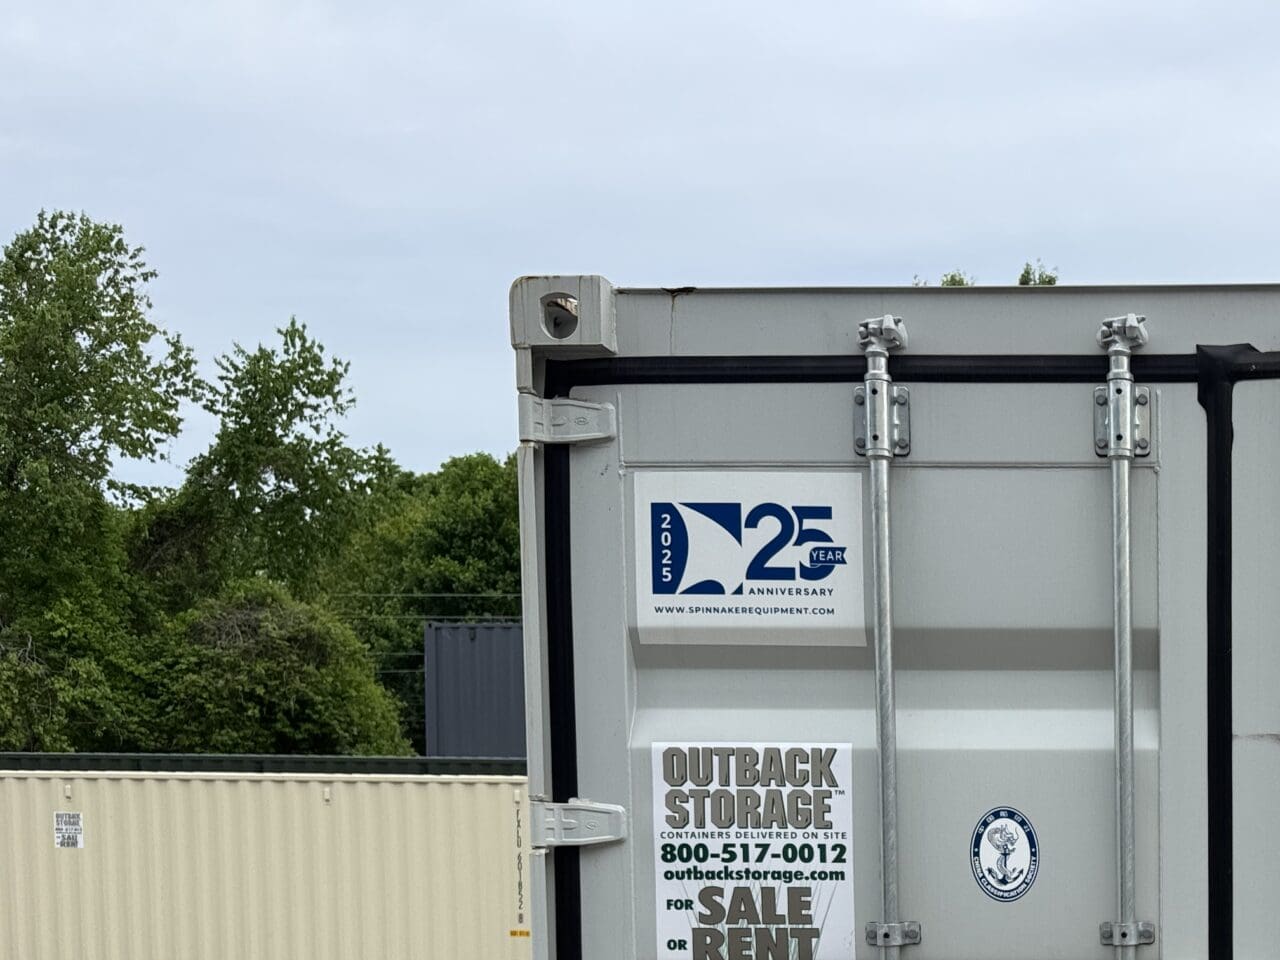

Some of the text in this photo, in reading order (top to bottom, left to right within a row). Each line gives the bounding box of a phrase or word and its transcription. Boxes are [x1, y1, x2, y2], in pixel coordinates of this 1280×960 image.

[660, 513, 673, 582] 2025
[744, 503, 844, 581] 25 YEAR
[748, 587, 834, 597] ANNIVERSARY
[653, 605, 836, 616] WWW.SPINNAKEREQUIPMENT.COM
[662, 747, 839, 788] OUTBACK
[665, 789, 833, 830] STORAGE
[660, 831, 731, 839] CONTAINERS
[735, 831, 798, 839] DELIVERED
[824, 832, 847, 840] SITE
[660, 843, 847, 863] 800-517-0012
[663, 866, 846, 883] outbackstorage.com
[666, 886, 813, 926] FOR SALE
[667, 939, 688, 951] OR
